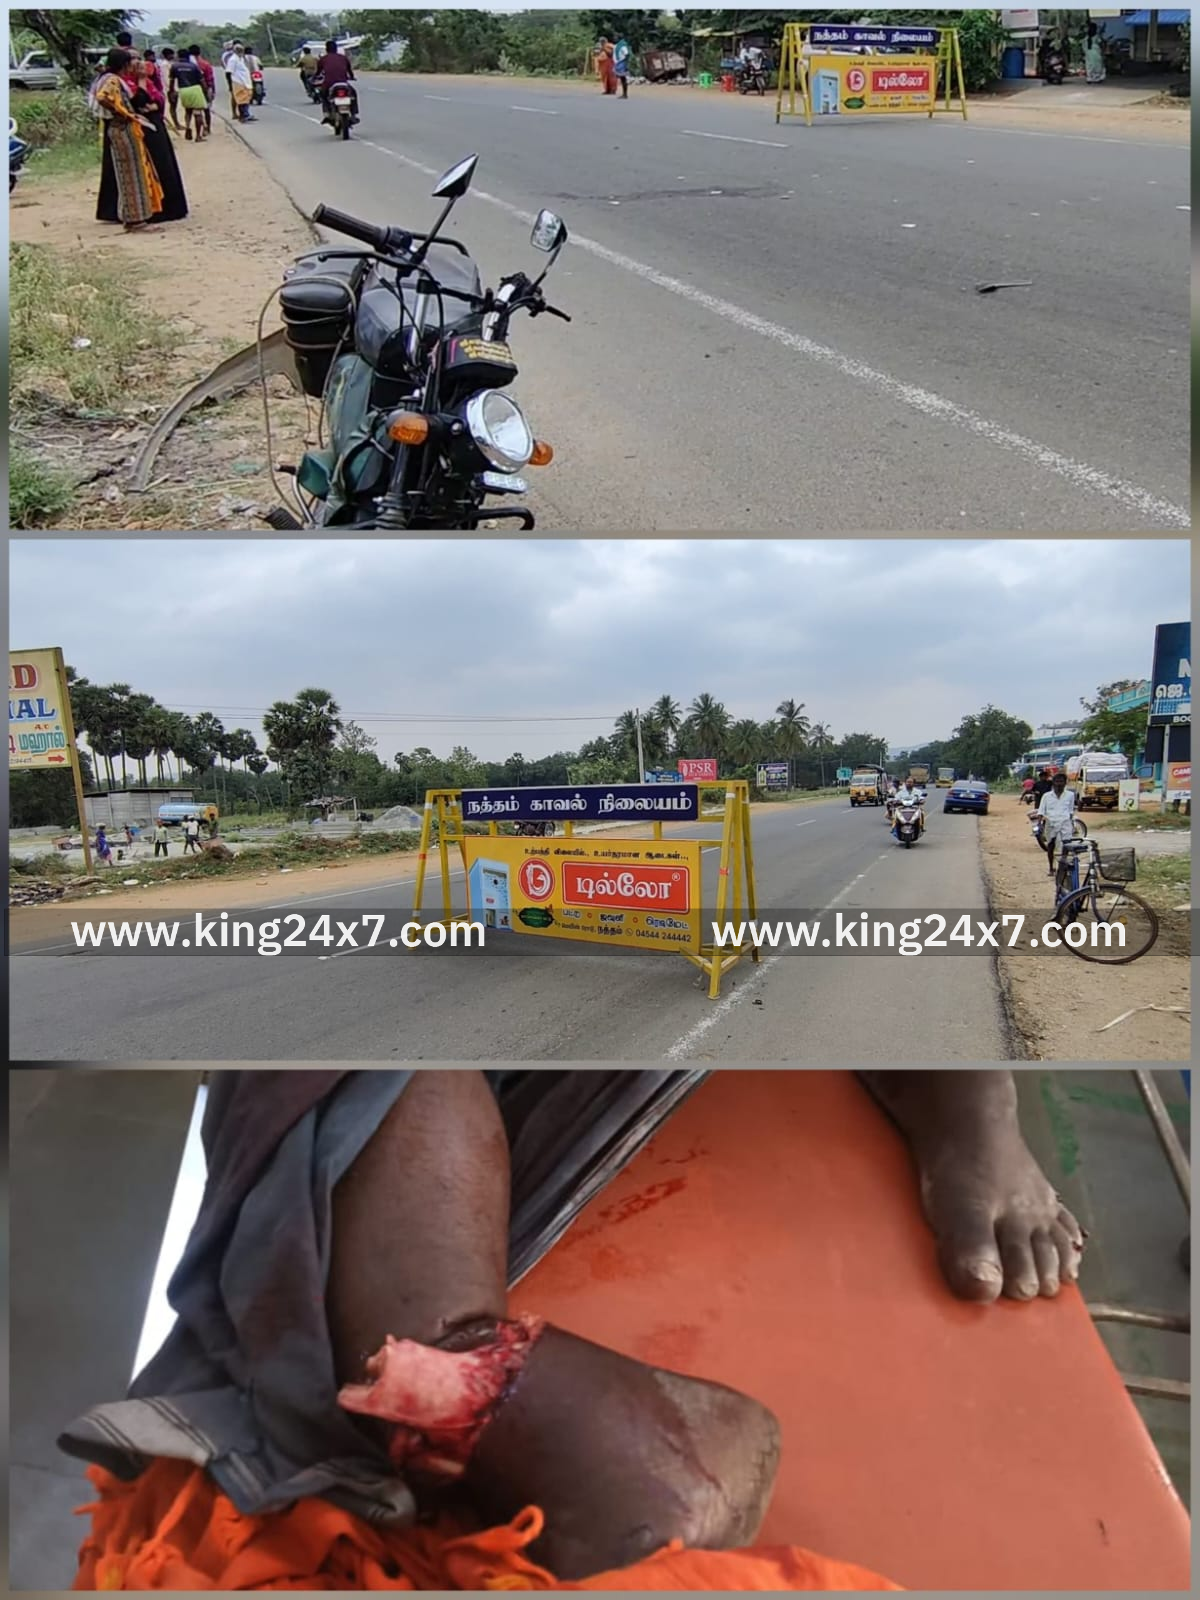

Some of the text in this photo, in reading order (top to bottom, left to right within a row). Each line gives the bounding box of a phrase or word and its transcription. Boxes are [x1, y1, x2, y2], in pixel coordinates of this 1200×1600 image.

[813, 30, 933, 43] நத்தம் காவல் நிலையம்
[878, 72, 923, 89] டில்லோ
[689, 762, 712, 773] PSR
[467, 791, 692, 815] நத்தம் காவல் நிலையம்
[576, 872, 672, 899] டில்லோ
[635, 928, 659, 939] 04544
